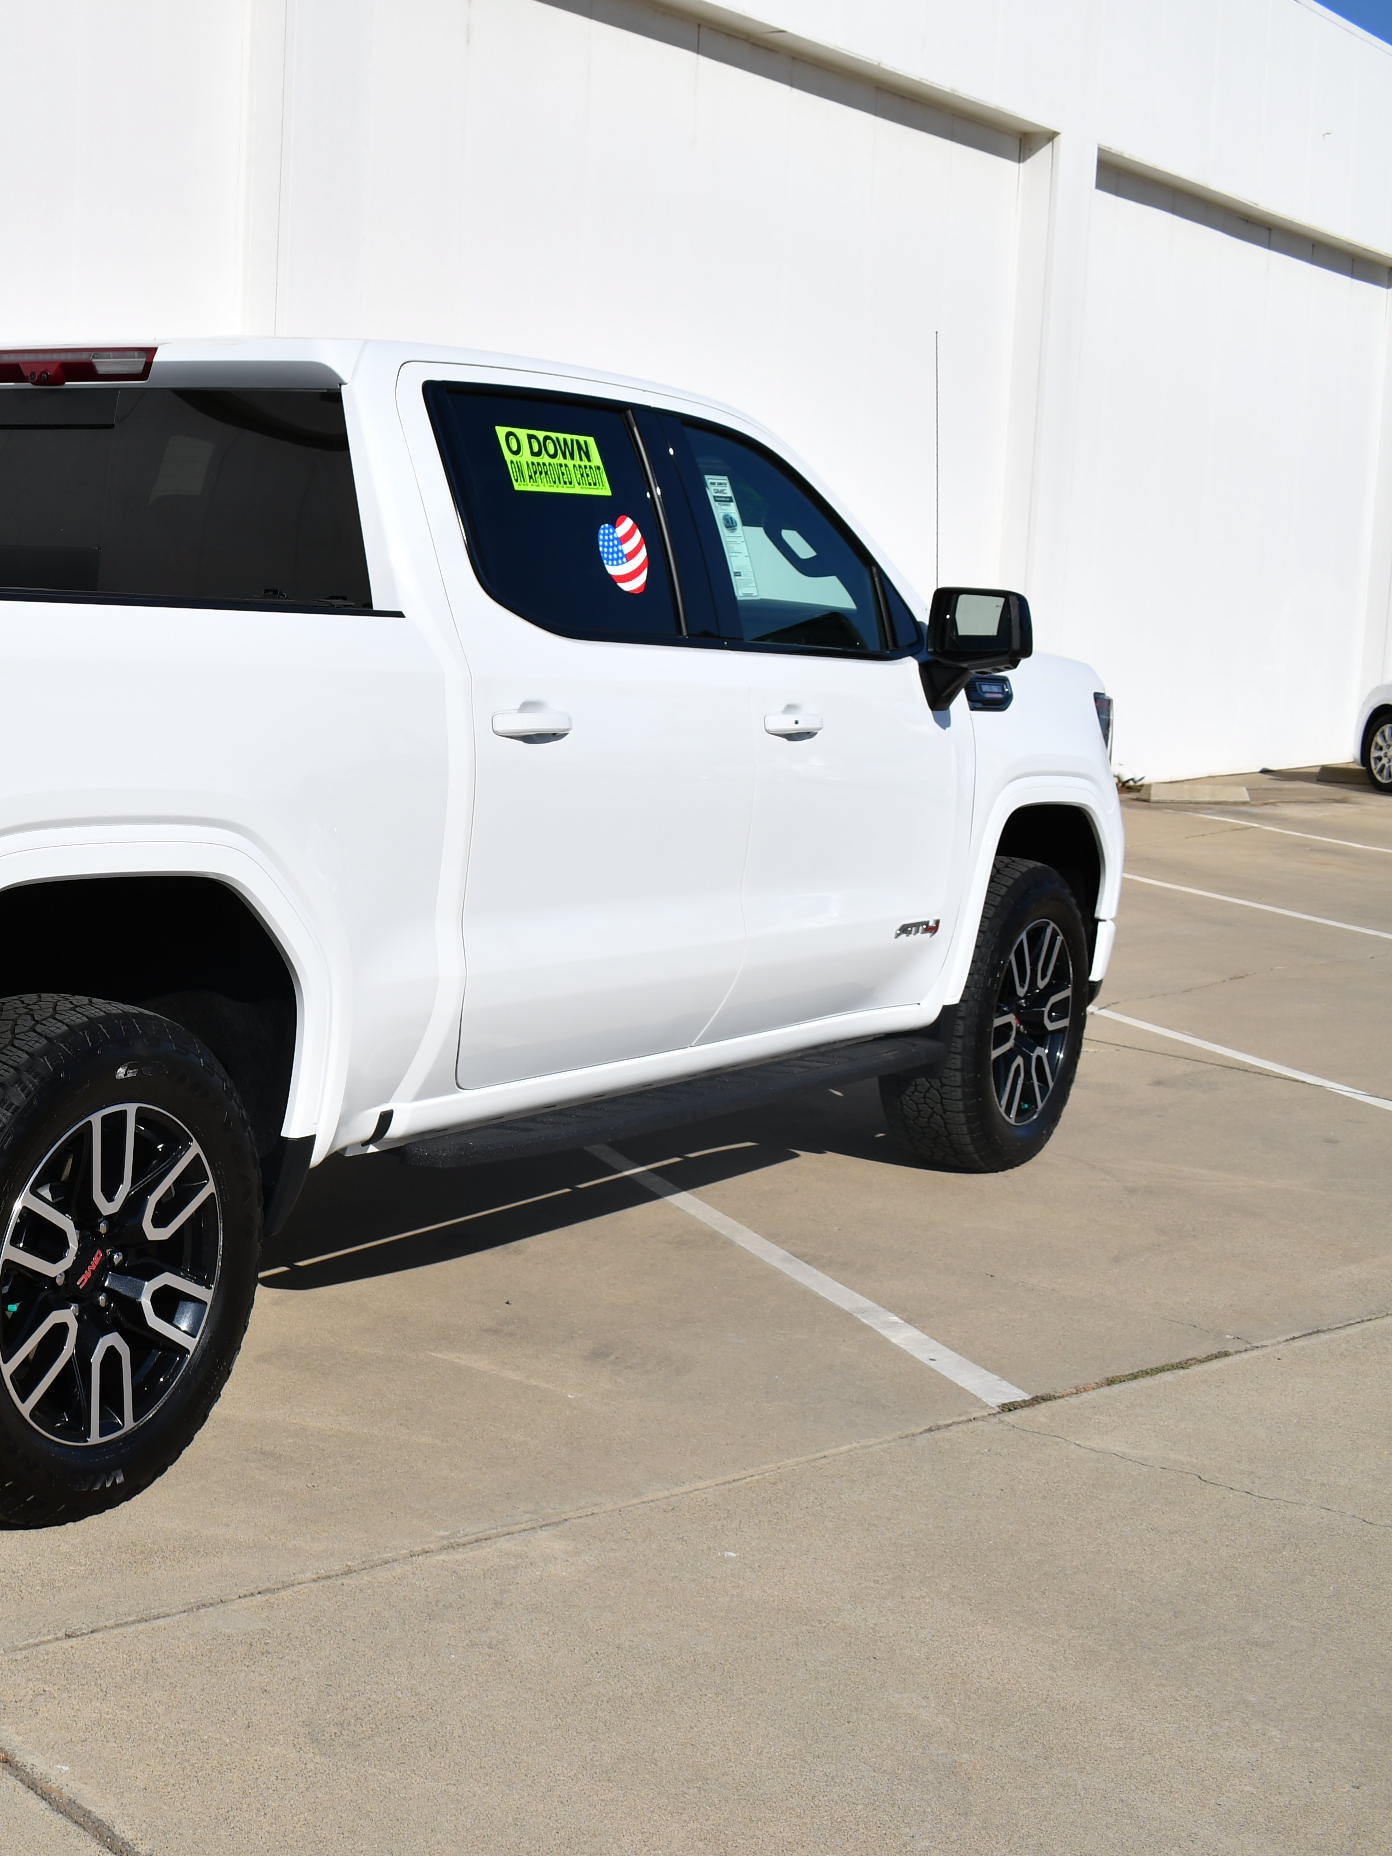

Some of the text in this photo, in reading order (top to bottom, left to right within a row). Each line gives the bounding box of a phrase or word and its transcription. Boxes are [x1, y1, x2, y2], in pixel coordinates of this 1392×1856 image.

[526, 433, 592, 462] DOWN
[509, 459, 606, 487] ON APPROVED CREDIT
